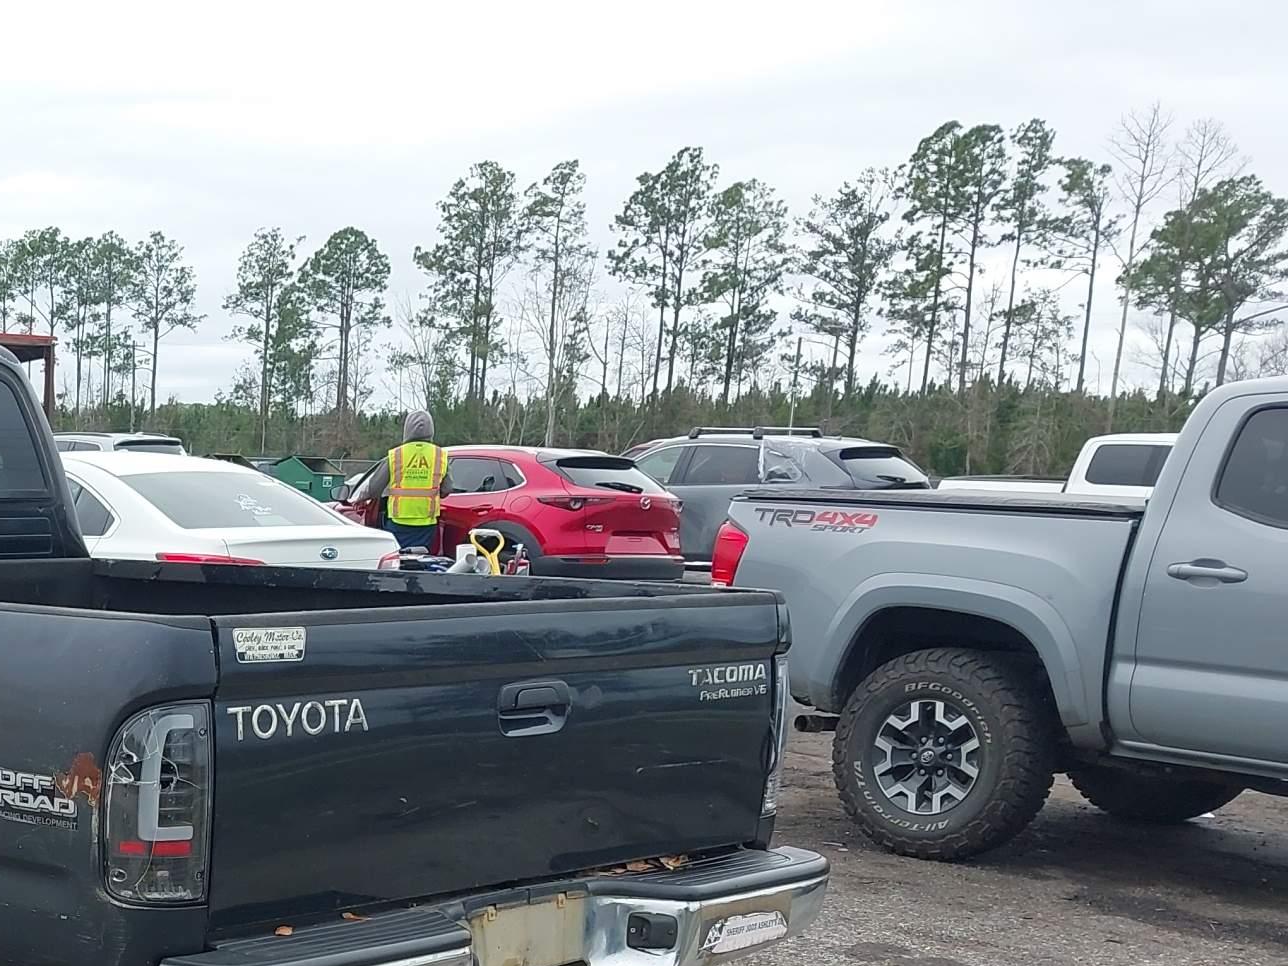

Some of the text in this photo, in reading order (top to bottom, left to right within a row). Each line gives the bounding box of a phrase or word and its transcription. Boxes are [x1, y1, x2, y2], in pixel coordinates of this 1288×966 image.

[755, 508, 816, 527] TRD
[811, 524, 870, 533] SPORT
[688, 663, 767, 686] TACOMA
[753, 684, 767, 695] V6
[227, 698, 369, 742] TOYOTA
[904, 681, 992, 744] BFGoodrich
[22, 814, 78, 829] DEVELOPMENT
